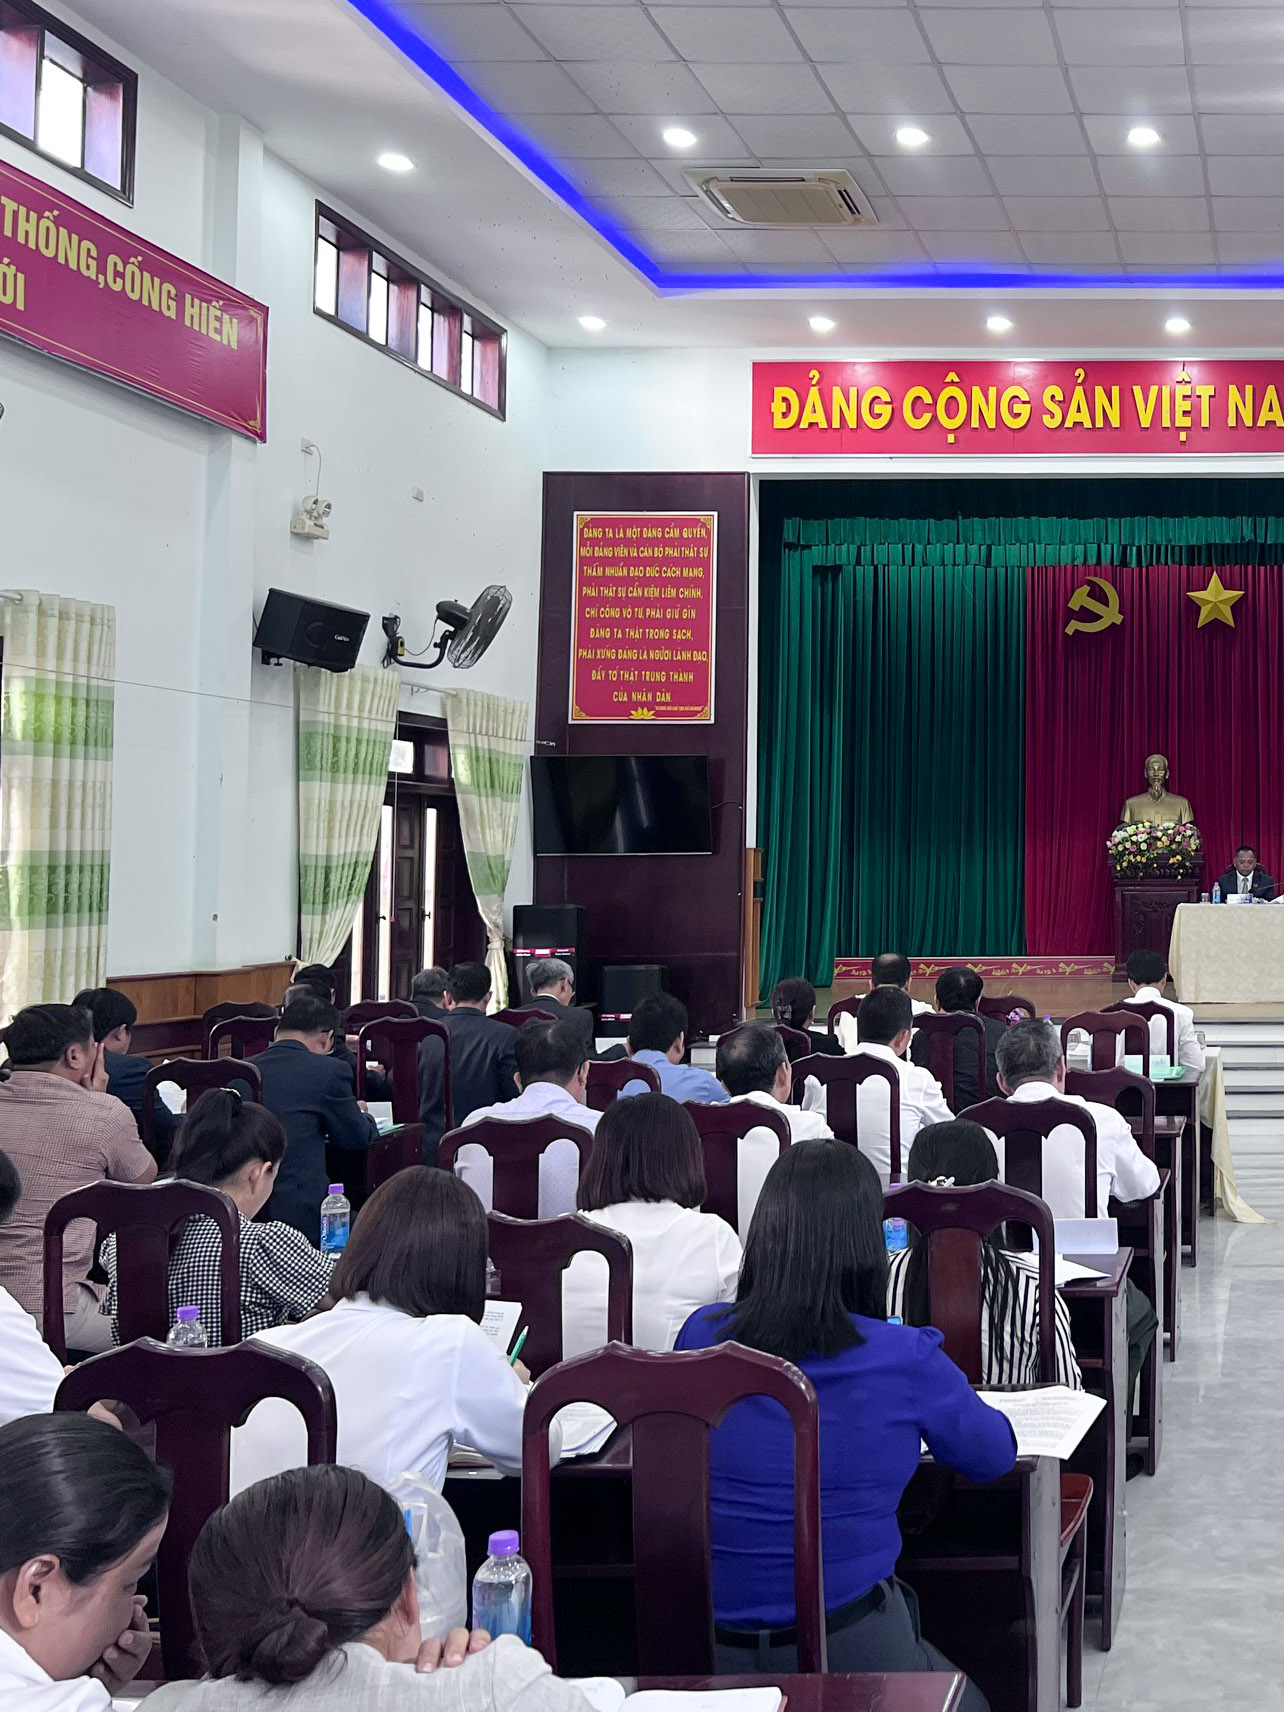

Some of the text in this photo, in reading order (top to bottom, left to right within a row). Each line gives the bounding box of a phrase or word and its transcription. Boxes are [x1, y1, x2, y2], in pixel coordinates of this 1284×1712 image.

[184, 293, 238, 350] HIẾN
[771, 370, 893, 430] ĐẢNG
[902, 371, 1032, 443] CỘNG
[1041, 368, 1121, 430] SẢN
[1132, 370, 1216, 442] VIỆT
[584, 525, 602, 539] ĐẢNG
[606, 528, 613, 538] TA
[616, 525, 624, 538] LÀ
[626, 525, 640, 541] MỘT
[643, 525, 662, 538] ĐẢNG
[595, 542, 612, 557] ĐẢNG
[614, 544, 628, 557] VIÊN
[630, 544, 637, 557] VÀ
[665, 543, 680, 557] PHẢI
[682, 545, 697, 561] THẬT
[630, 567, 644, 579] ĐẠO
[646, 565, 660, 577] ĐỨC
[662, 564, 681, 577] CÁCH
[583, 583, 598, 597] PHẢI
[600, 584, 616, 599] THẬT
[662, 585, 676, 598] LIÊM
[585, 604, 597, 618] CHÍ
[600, 604, 620, 618] CÔNG
[623, 605, 632, 618] VÔ
[646, 605, 663, 618] PHẢI
[682, 605, 696, 618] GÌN
[590, 624, 610, 638] ĐẢNG
[614, 628, 622, 638] TA
[626, 626, 643, 642] THẬT
[645, 629, 669, 639] TRONG
[578, 645, 595, 659] PHẢI
[618, 645, 637, 660] ĐÁNG
[639, 647, 647, 660] LÀ
[620, 668, 638, 684] THẬT
[641, 672, 666, 682] TRUNG
[670, 670, 693, 682] THÀNH
[613, 687, 627, 702] CỦA
[632, 688, 652, 702] NHÂN
